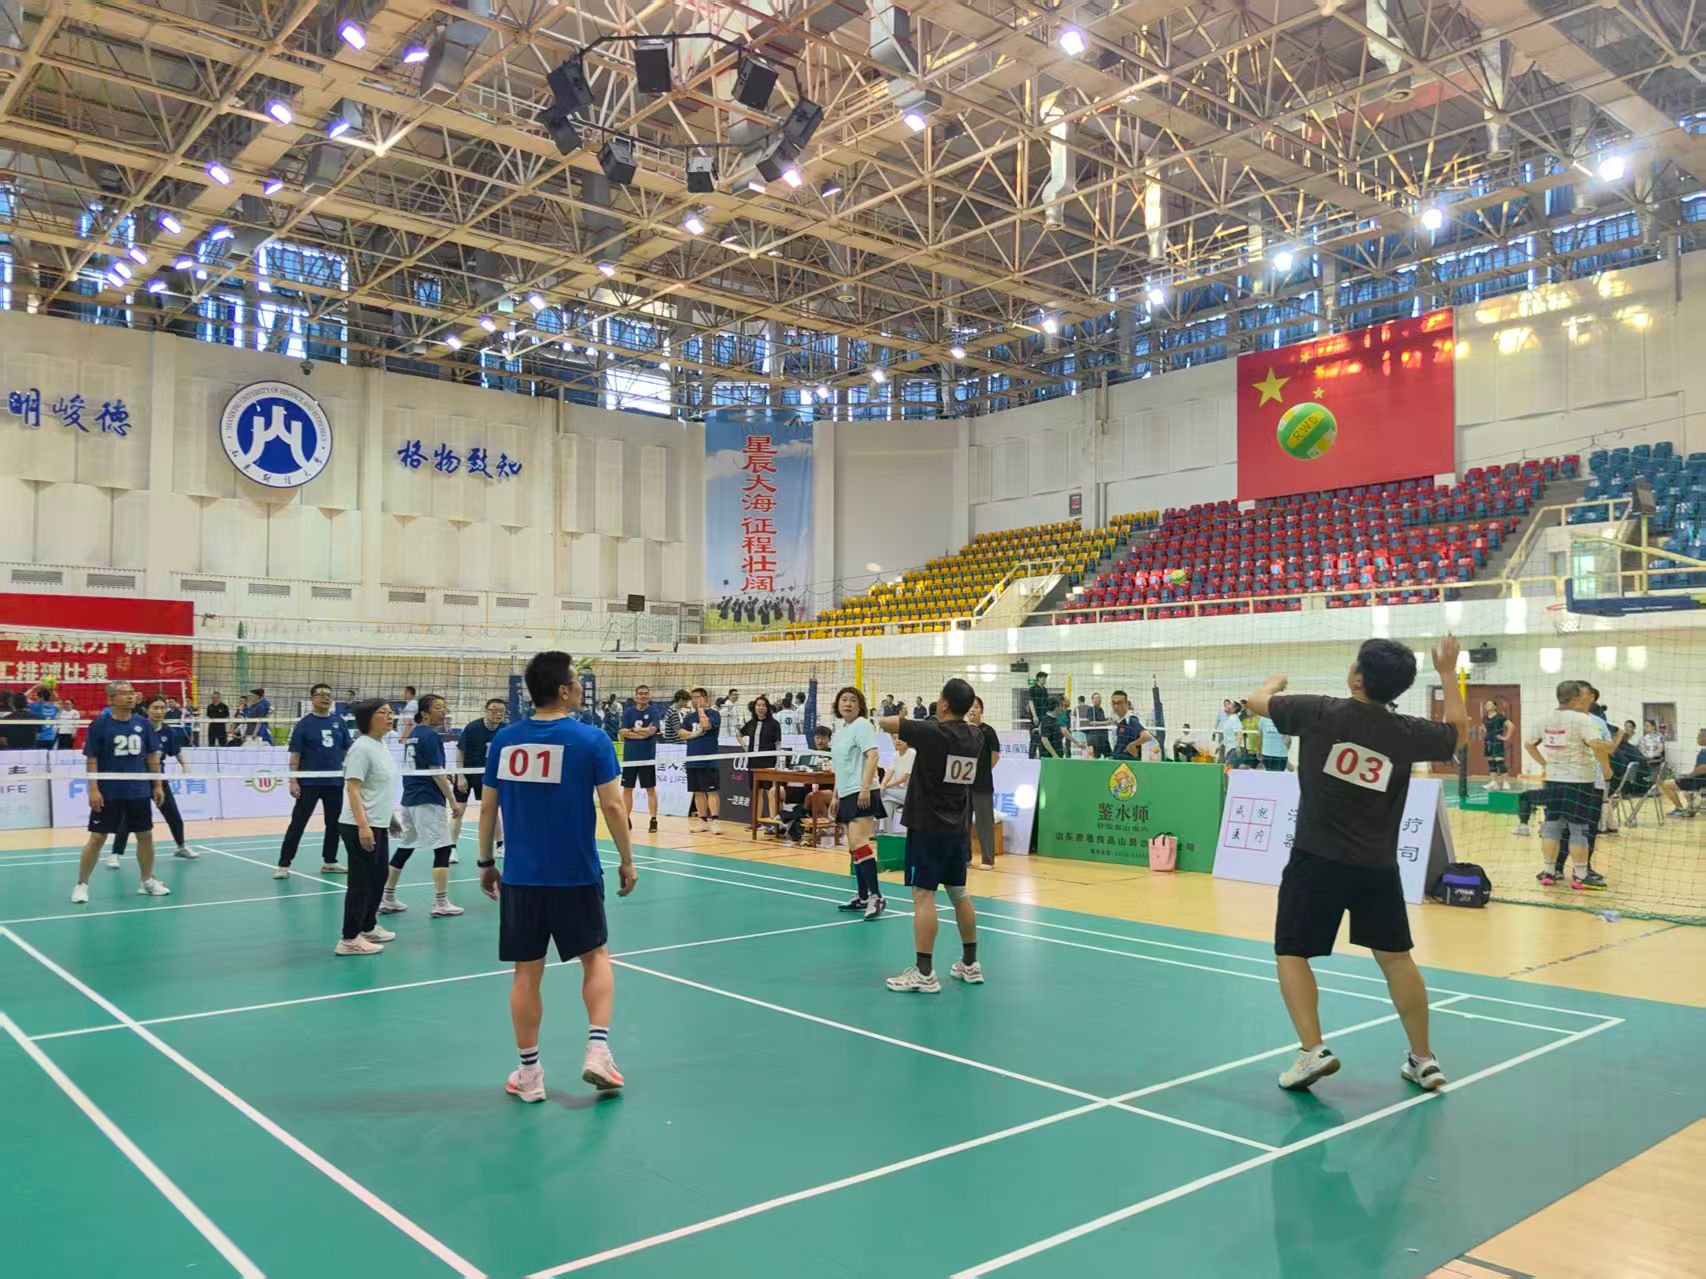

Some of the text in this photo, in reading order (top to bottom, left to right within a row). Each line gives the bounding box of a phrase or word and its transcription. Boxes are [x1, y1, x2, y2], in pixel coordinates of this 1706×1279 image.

[8, 387, 132, 437] 明峻德
[740, 434, 778, 593] 星辰大海 征程壮阔
[113, 735, 142, 757] 20
[321, 730, 334, 748] 5
[509, 748, 550, 778] 01
[950, 761, 974, 782] 02
[1335, 747, 1384, 783] 03
[1097, 802, 1150, 823] 鉴水师
